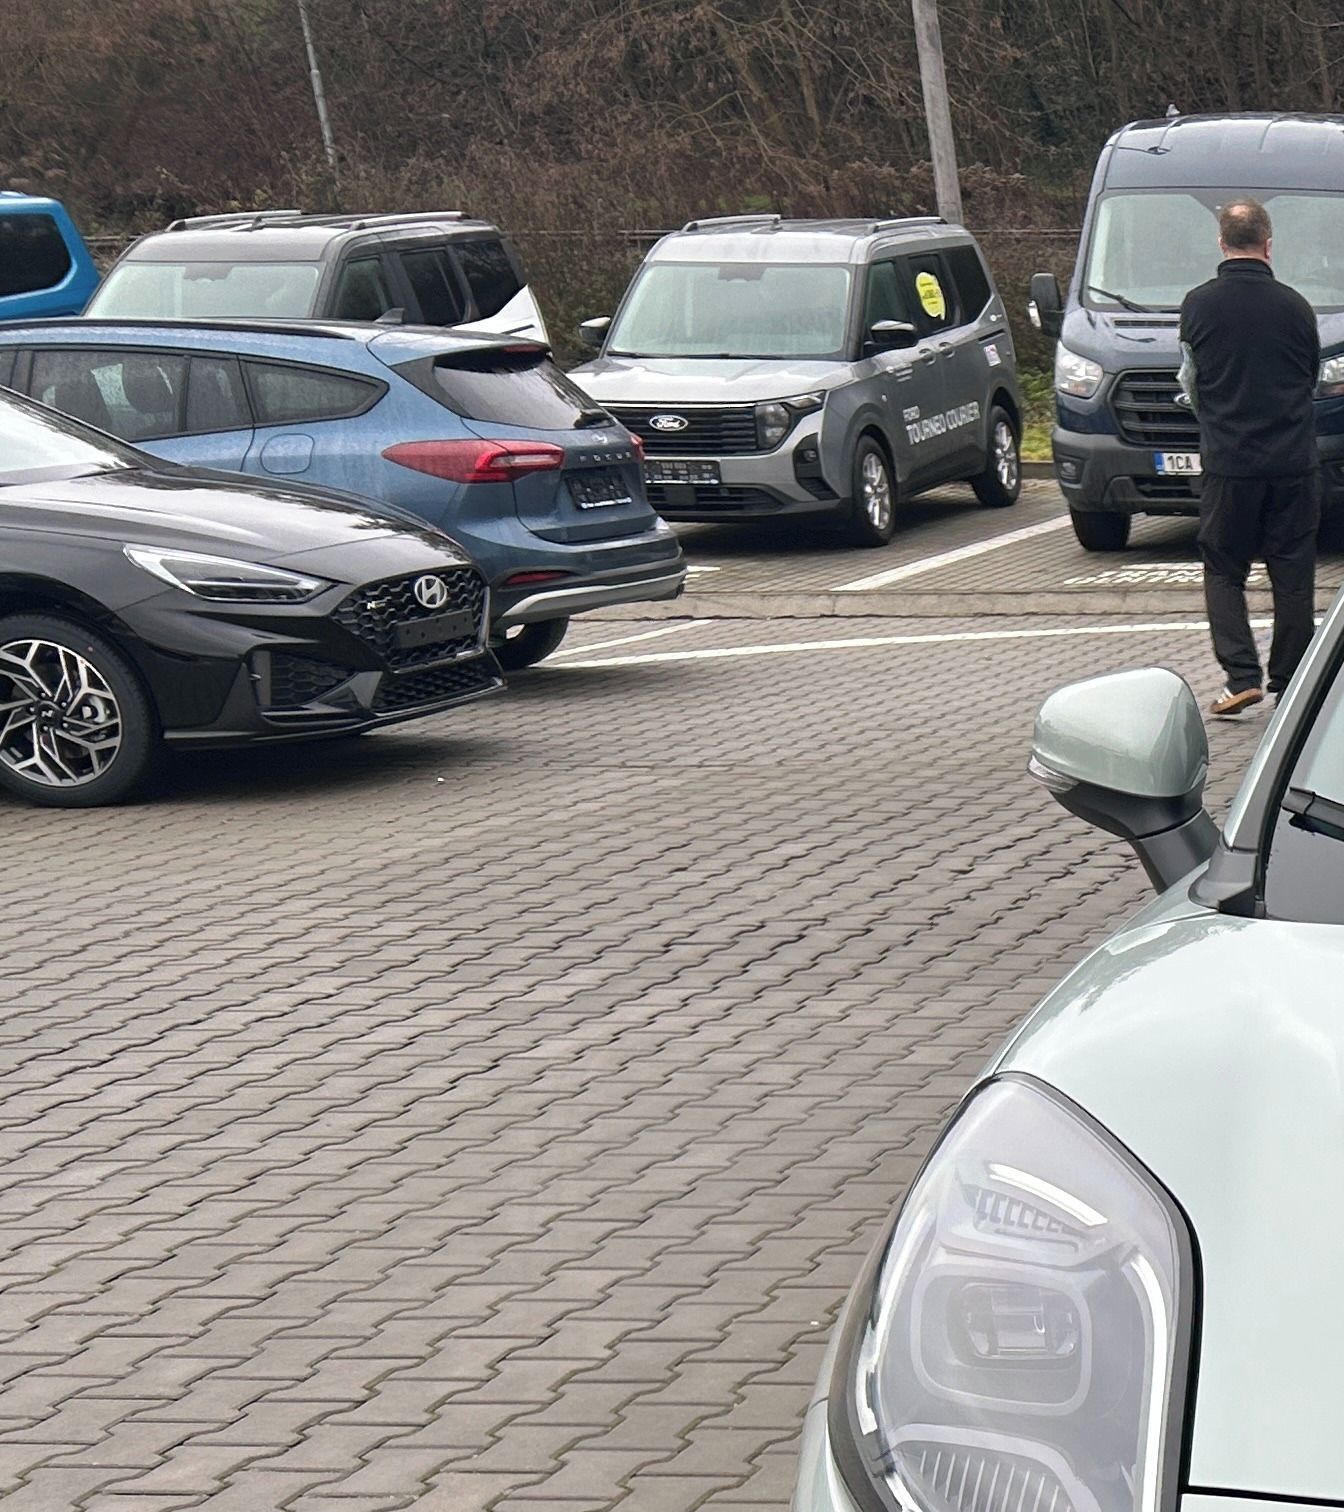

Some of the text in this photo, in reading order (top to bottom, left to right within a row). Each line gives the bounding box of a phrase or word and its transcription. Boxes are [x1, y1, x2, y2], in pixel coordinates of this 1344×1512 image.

[905, 401, 981, 445] TOURNEO COURIER
[1167, 456, 1194, 470] 1CA
